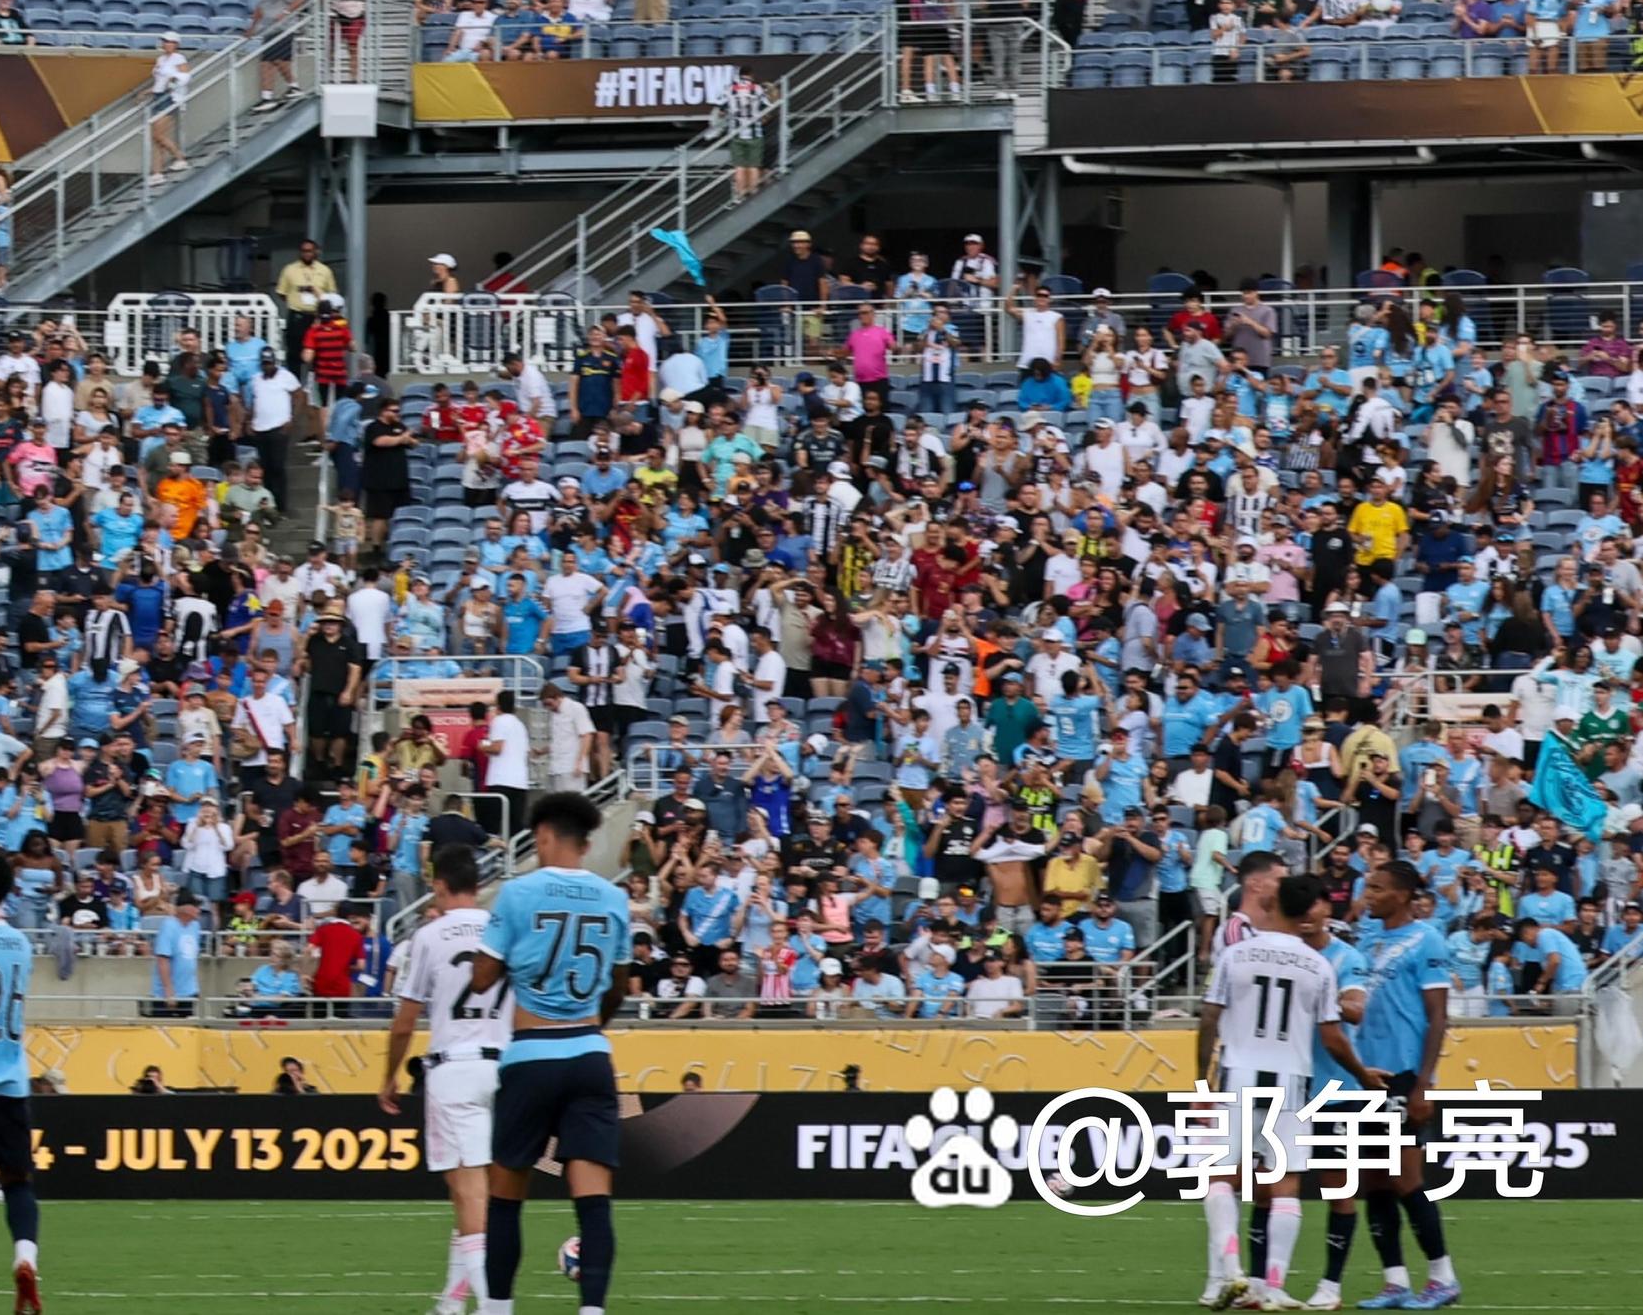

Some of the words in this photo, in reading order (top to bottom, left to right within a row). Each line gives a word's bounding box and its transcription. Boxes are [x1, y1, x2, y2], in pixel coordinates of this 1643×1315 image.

[594, 64, 740, 108] #FIFACW
[531, 909, 612, 1003] 75
[1253, 974, 1296, 1042] 11
[95, 1127, 223, 1171] JULY
[231, 1127, 284, 1171] 13
[292, 1127, 420, 1171] 2025
[797, 1124, 910, 1170] FIFA
